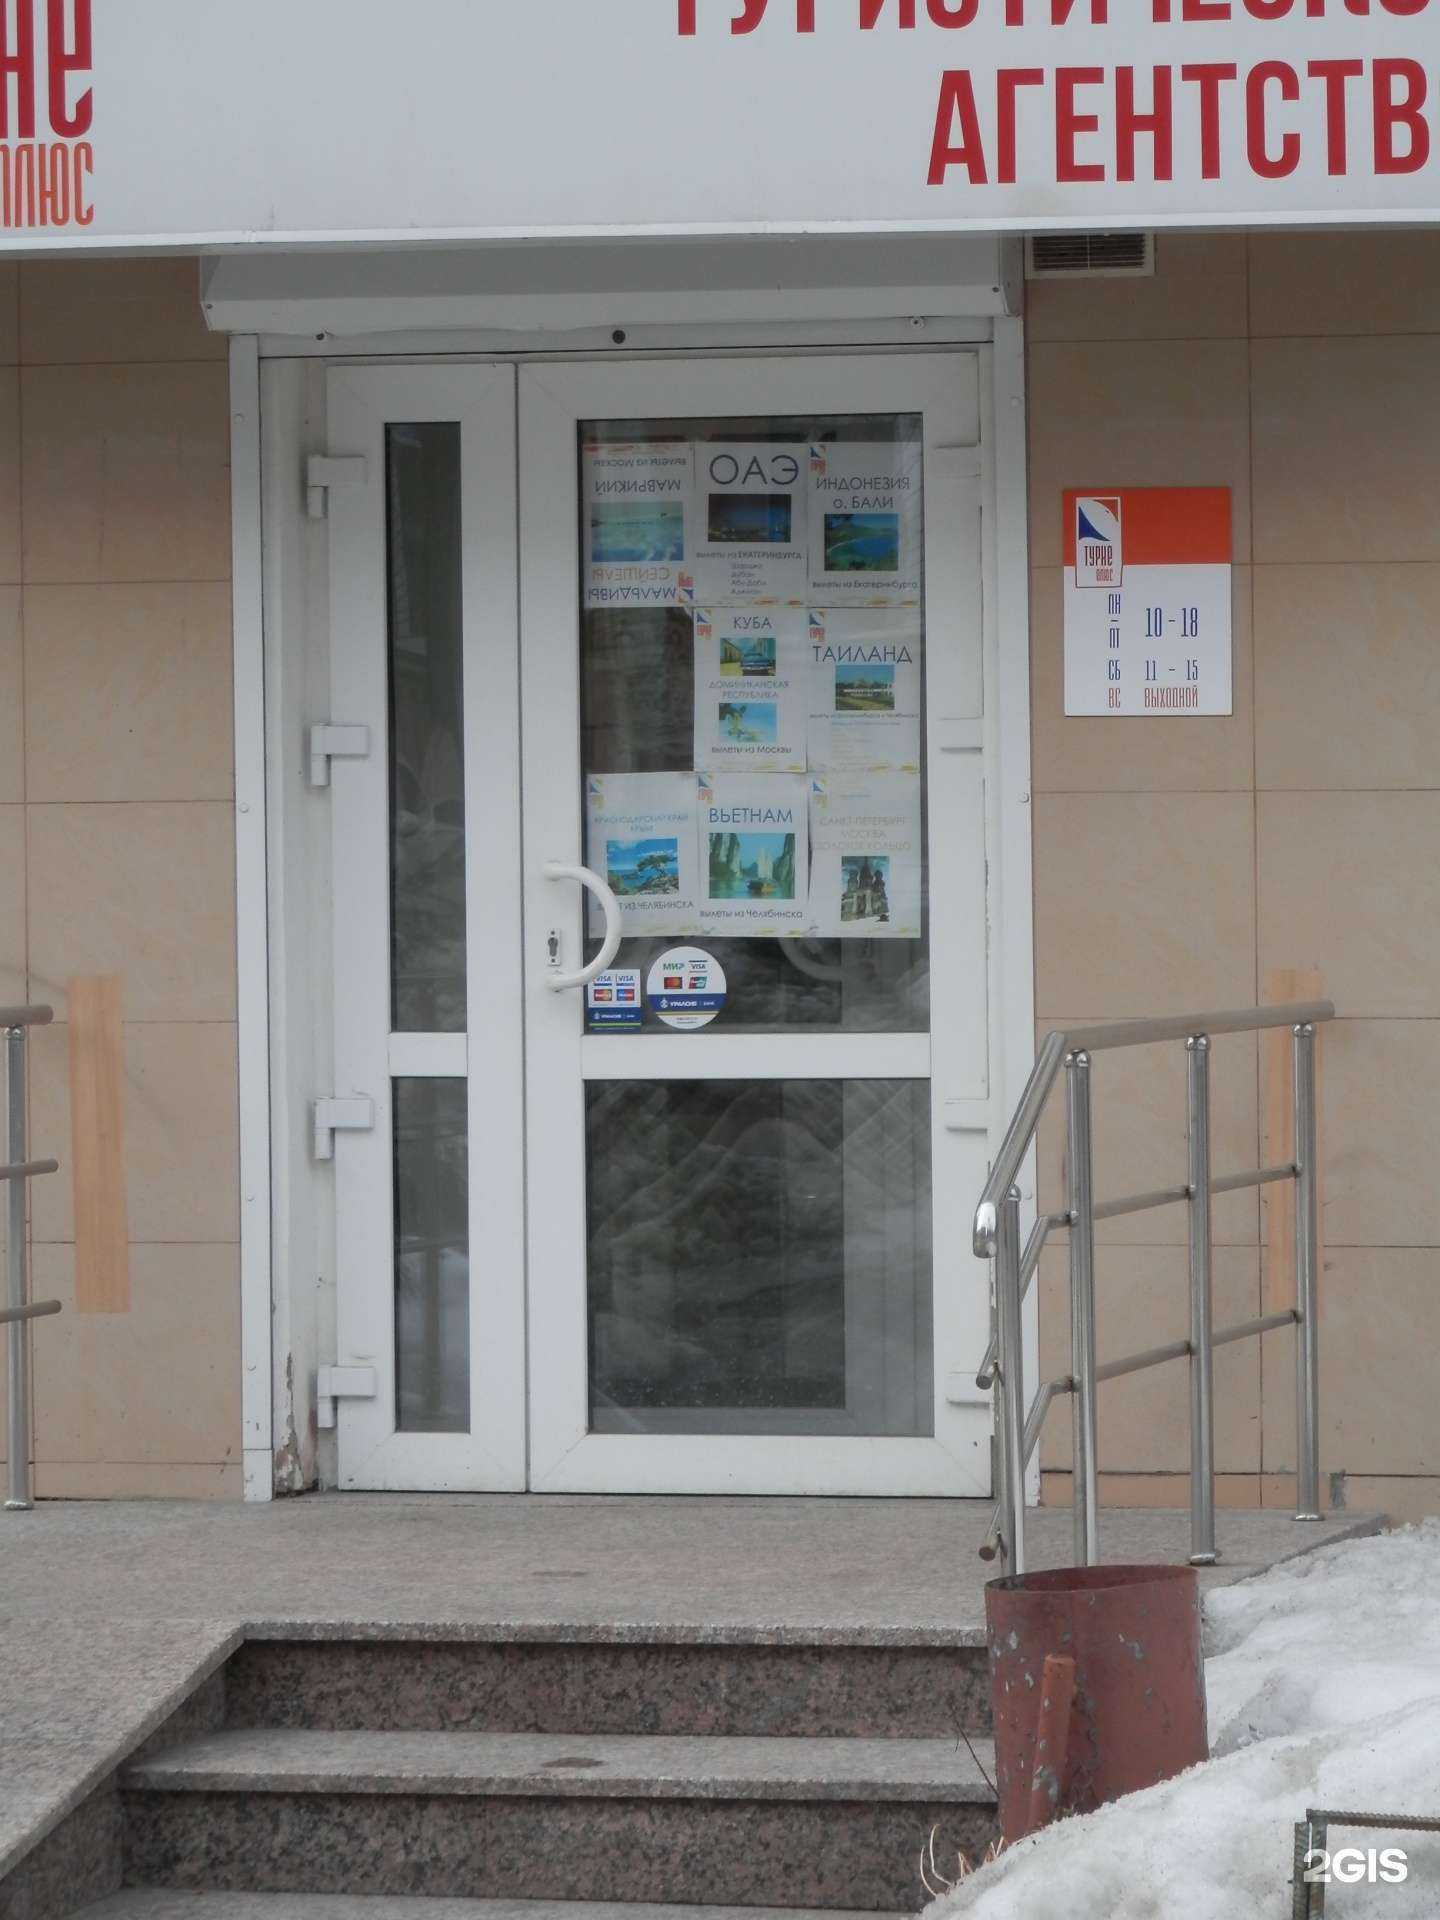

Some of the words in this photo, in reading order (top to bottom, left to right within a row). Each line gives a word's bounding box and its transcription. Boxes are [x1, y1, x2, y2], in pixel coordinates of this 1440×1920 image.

[926, 57, 1431, 186] АГЕНТСТВ
[709, 454, 798, 485] ОАЭ
[594, 479, 681, 496] МАВРИКИЙ
[816, 477, 910, 492] ИНДОНЕЗИЯ
[852, 495, 894, 509] БАЛИ
[593, 566, 671, 584] СЕЙШЕЛЫ
[588, 586, 677, 600] МАЛЬДИВЫ
[1108, 593, 1121, 615] ПН
[733, 616, 772, 630] КУБА
[1145, 607, 1163, 638] 10
[1180, 607, 1198, 638] 18
[1109, 627, 1120, 649] ПТ
[812, 645, 912, 664] ТАИЛАНД
[1108, 659, 1121, 681] СБ
[1145, 660, 1157, 681] 11
[1186, 659, 1198, 681] 15
[1108, 687, 1121, 709] ВС
[1144, 684, 1199, 708] ВЫХОДНОЙ
[708, 807, 793, 824] ВЬЕТНАМ
[746, 908, 803, 919] Челябинска
[663, 962, 685, 970] МИР
